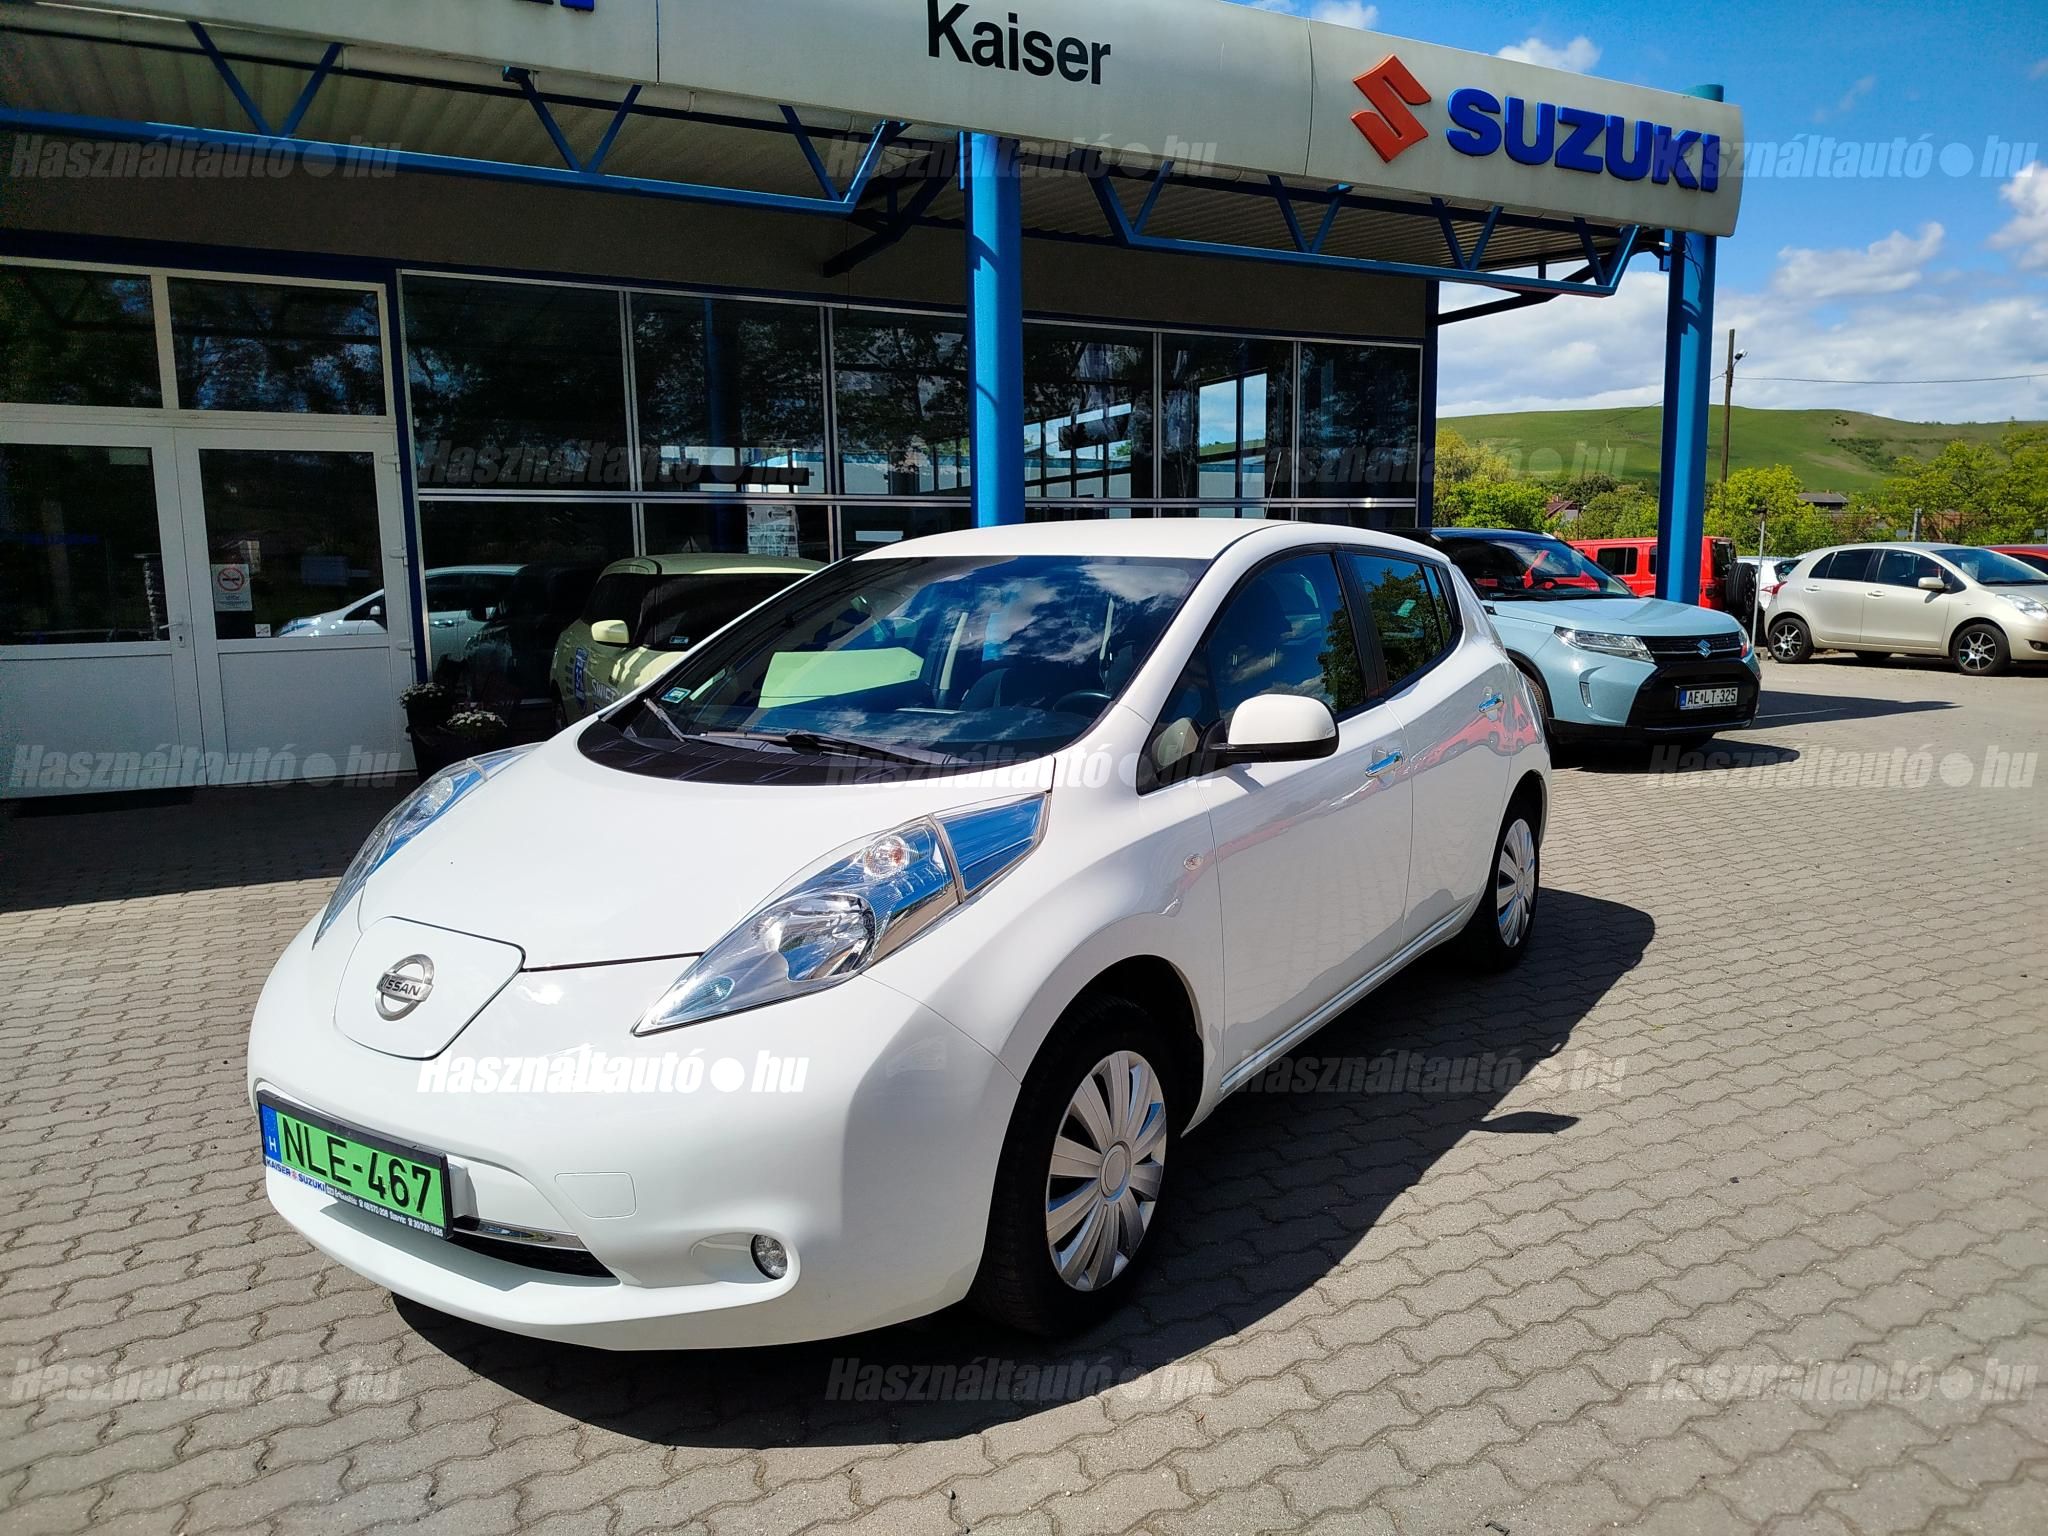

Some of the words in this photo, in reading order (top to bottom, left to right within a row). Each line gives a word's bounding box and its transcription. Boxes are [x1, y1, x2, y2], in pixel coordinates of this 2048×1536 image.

[927, 0, 1111, 85] Kaiser
[1445, 88, 1718, 193] SUZUKI
[266, 1157, 291, 1177] KAISER
[298, 1172, 326, 1192] SUZUKI
[282, 1116, 432, 1214] NLE-467
